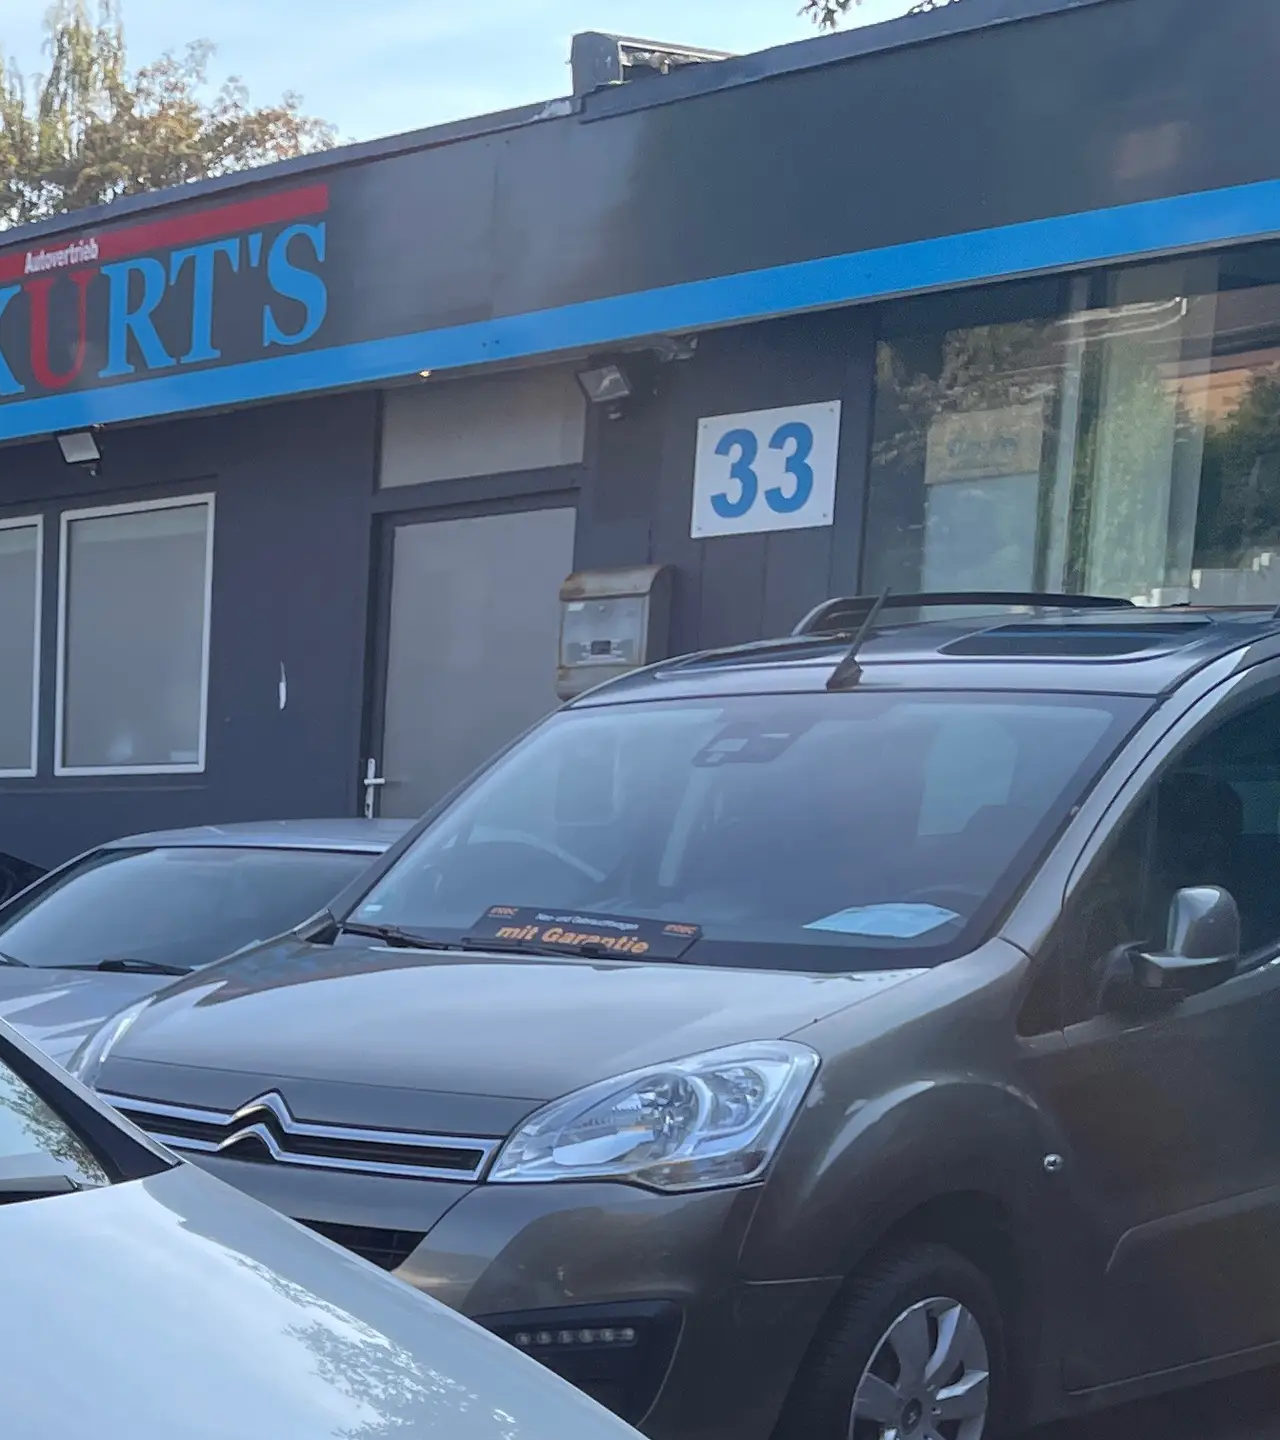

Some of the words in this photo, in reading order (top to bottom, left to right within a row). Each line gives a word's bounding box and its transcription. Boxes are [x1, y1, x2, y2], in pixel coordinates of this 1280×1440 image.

[24, 237, 99, 274] Autovertrieb
[710, 421, 814, 518] 33
[495, 924, 539, 941] mit
